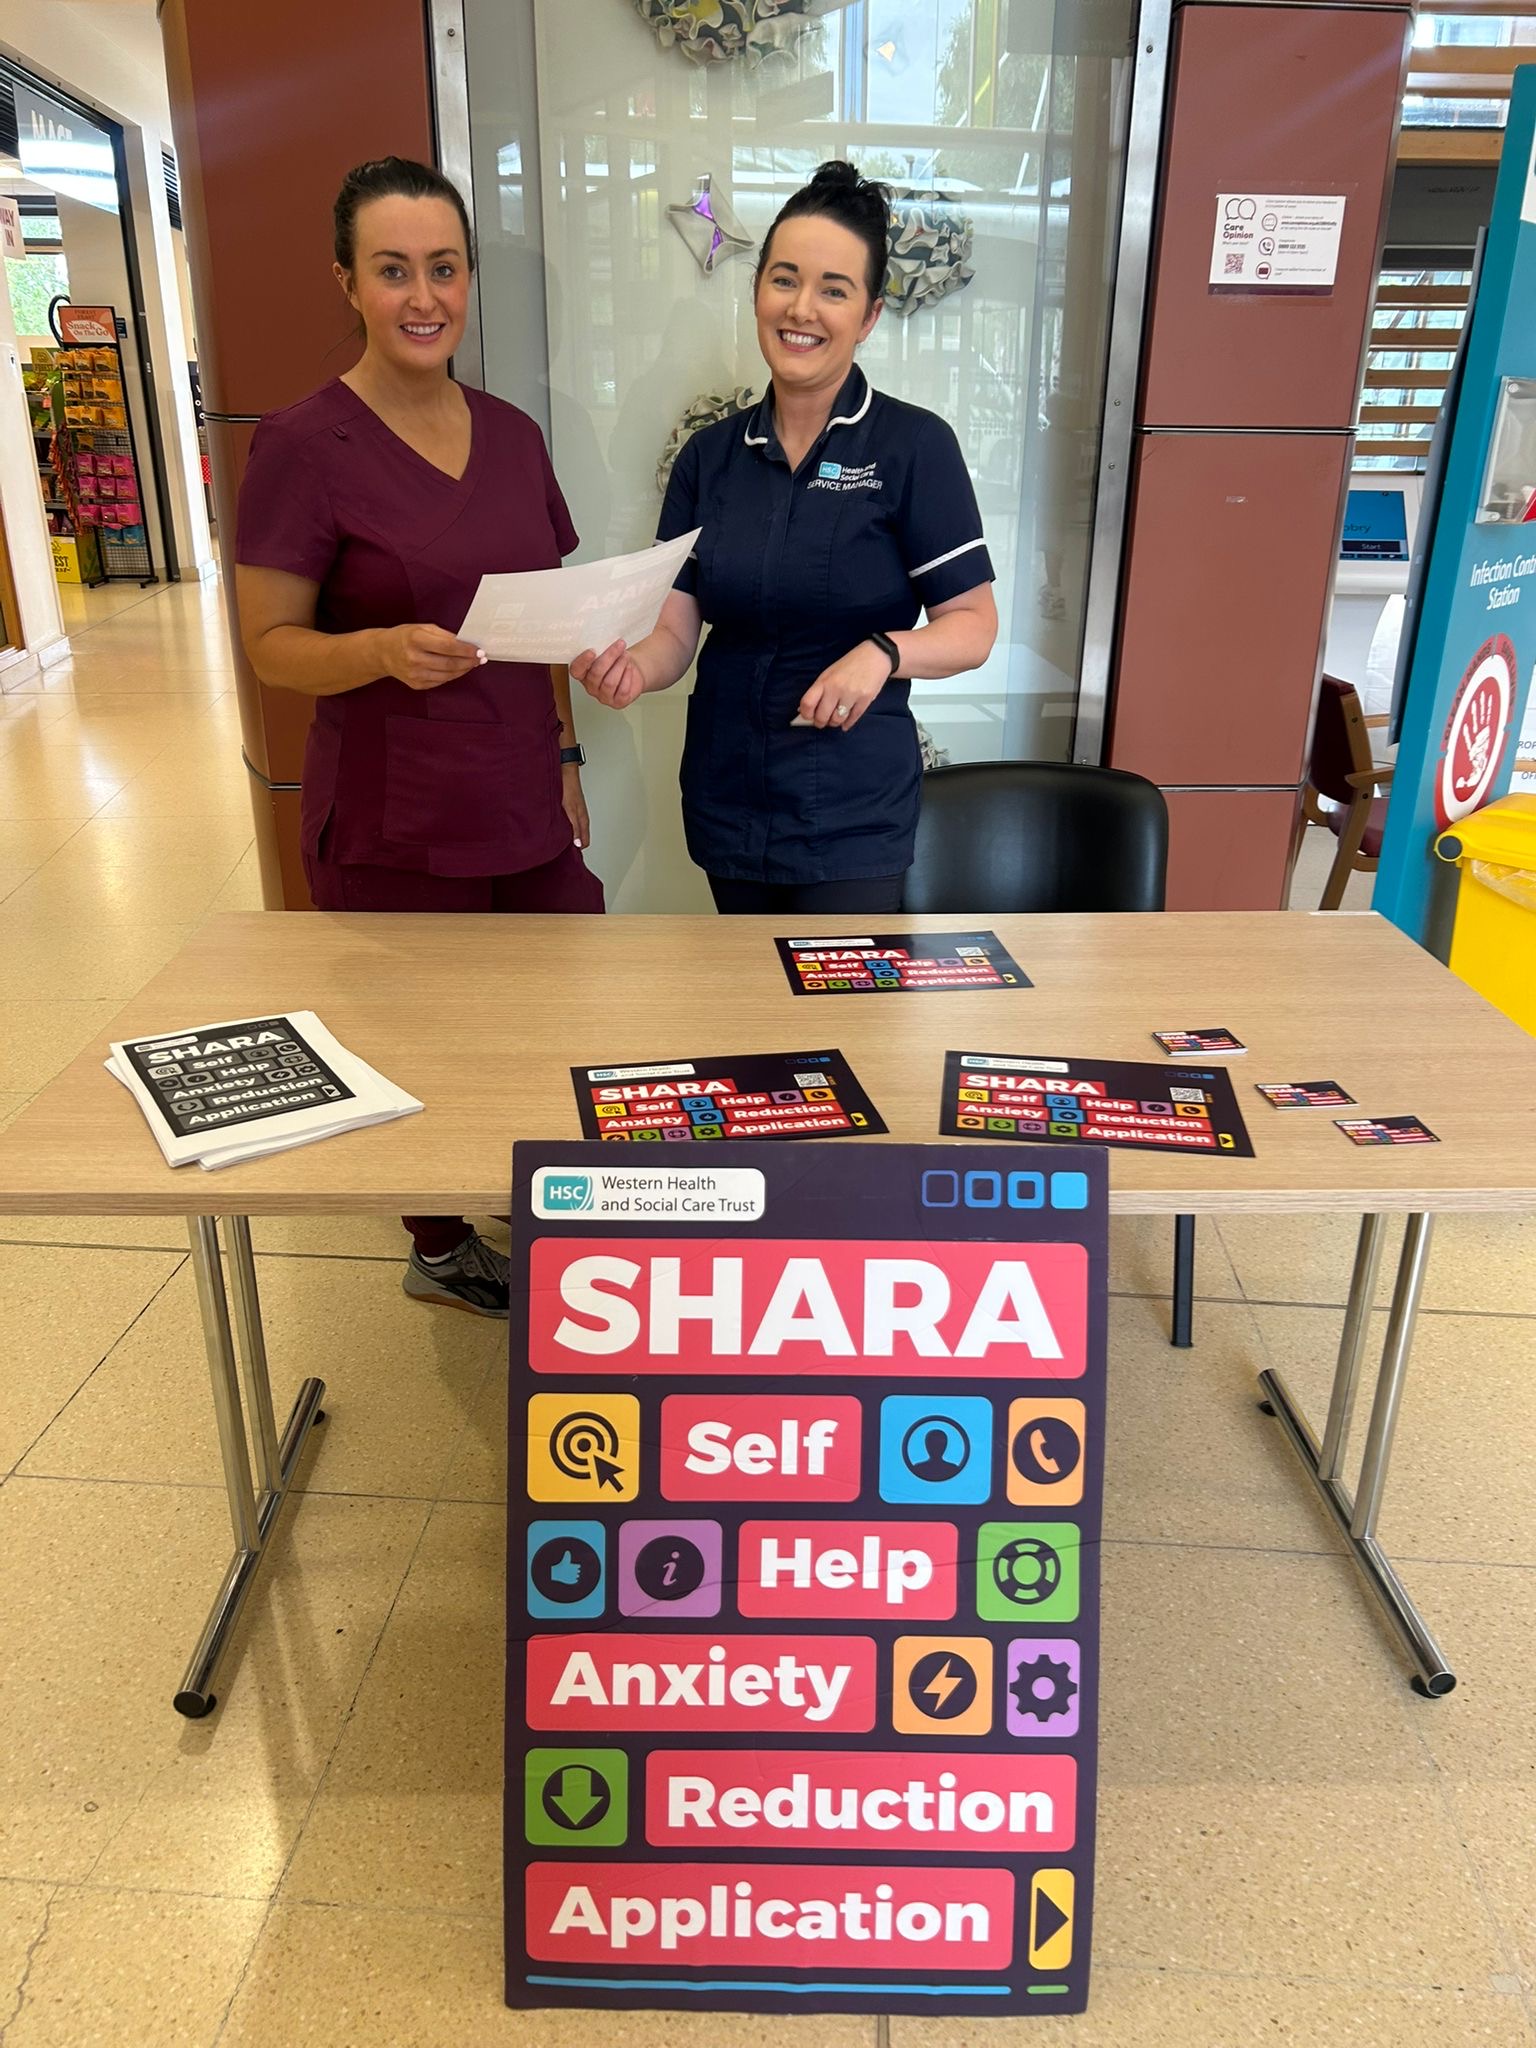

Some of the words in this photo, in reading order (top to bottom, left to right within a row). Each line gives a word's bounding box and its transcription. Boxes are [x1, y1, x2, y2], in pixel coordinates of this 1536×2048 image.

[1222, 231, 1254, 240] Opinion
[1223, 223, 1244, 231] Care
[68, 321, 96, 330] Snack
[95, 327, 109, 337] Go
[807, 479, 842, 491] SERVICE
[842, 479, 883, 491] MANAGER
[1470, 558, 1513, 588] Infection
[1486, 583, 1521, 611] Station
[799, 950, 905, 961] SHARA
[806, 971, 868, 979] Anxiety
[907, 967, 989, 975] Reduction
[905, 976, 999, 986] Application
[147, 1031, 285, 1065] SHARA
[192, 1055, 235, 1070] Self
[220, 1061, 271, 1078] Help
[172, 1077, 257, 1100] Anxiety
[212, 1076, 324, 1105] Reduction
[599, 1081, 732, 1101] SHARA
[965, 1075, 1100, 1095] SHARA
[188, 1091, 317, 1126] Application
[635, 1101, 675, 1112] Self
[720, 1095, 767, 1107] Help
[998, 1093, 1038, 1103] Self
[1086, 1099, 1134, 1111] Help
[605, 1115, 684, 1129] Anxiety
[733, 1103, 834, 1119] Reduction
[963, 1104, 1043, 1119] Anxiety
[1095, 1113, 1203, 1128] Reduction
[730, 1117, 846, 1134] Application
[1086, 1127, 1211, 1144] Application
[601, 1175, 663, 1190] Western
[667, 1175, 716, 1190] Health
[550, 1186, 584, 1200] HSC
[601, 1197, 630, 1212] and
[634, 1197, 677, 1212] Social
[682, 1198, 715, 1212] Care
[719, 1198, 755, 1213] Trust
[552, 1255, 1065, 1360] SHARA
[684, 1419, 839, 1476] Self
[759, 1535, 933, 1604] Help
[550, 1644, 852, 1722] Anxiety
[666, 1771, 1054, 1834] Reduction
[548, 1880, 990, 1950] Application
